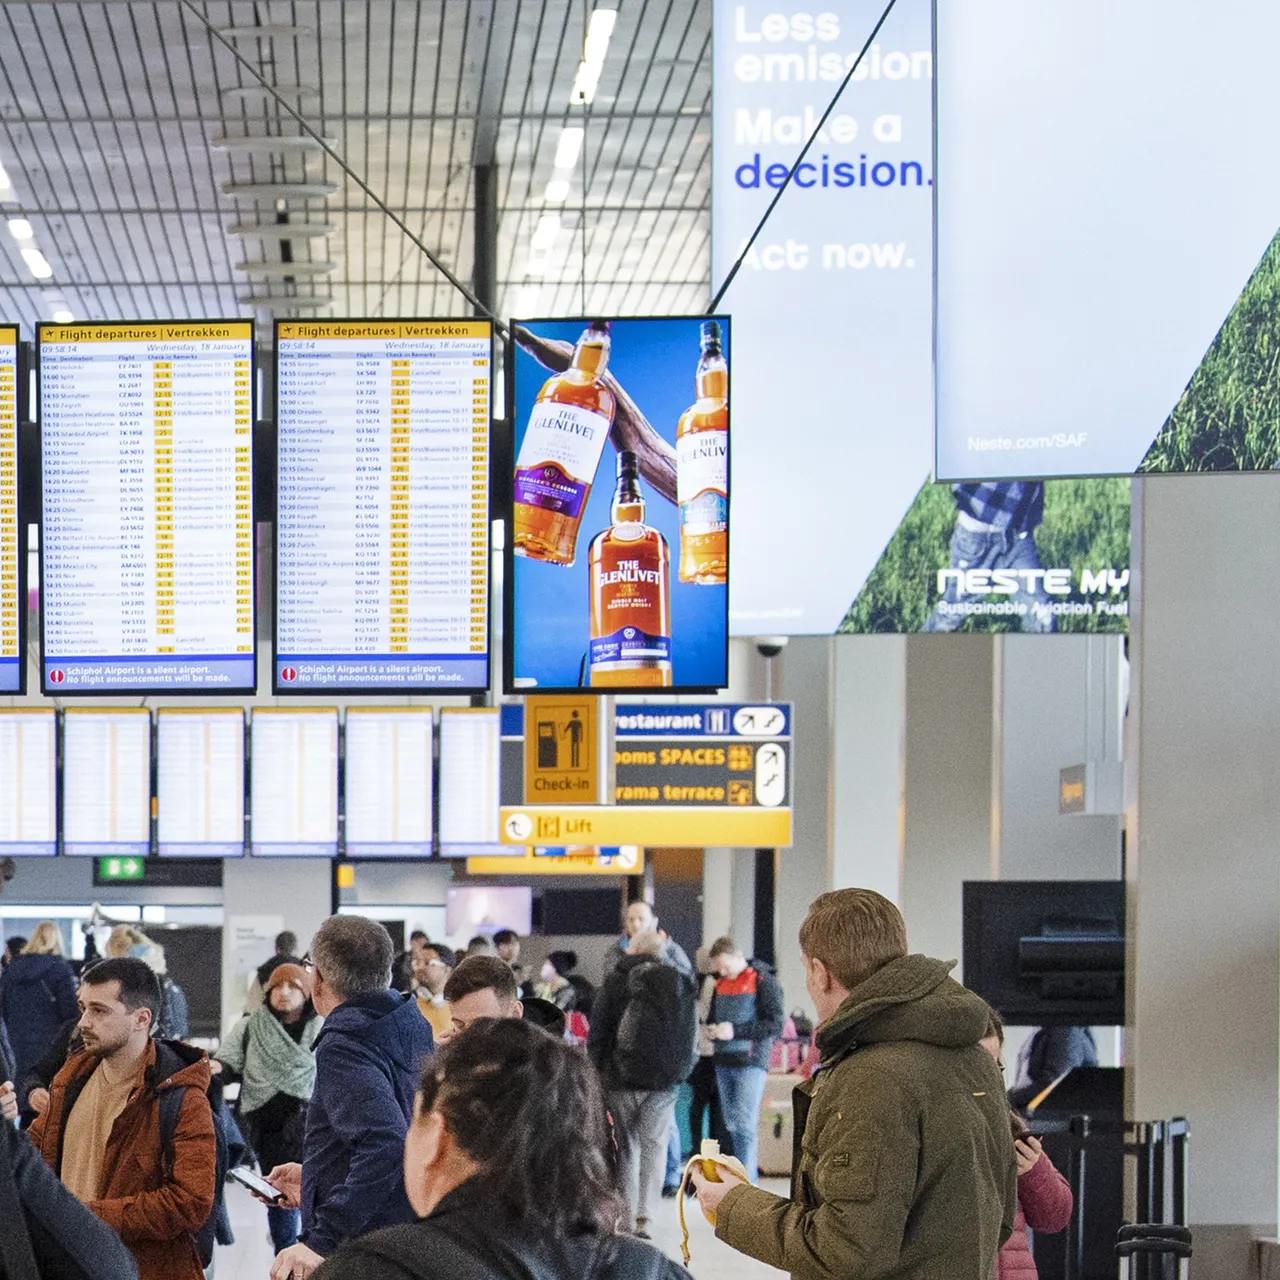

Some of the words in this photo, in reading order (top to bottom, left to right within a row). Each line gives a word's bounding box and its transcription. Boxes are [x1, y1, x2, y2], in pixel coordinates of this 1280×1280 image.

[736, 7, 840, 42] Less
[736, 105, 858, 145] Make
[874, 111, 901, 142] a
[735, 154, 933, 189] decision.
[736, 238, 810, 269] Act
[822, 241, 915, 269] now.
[60, 330, 92, 341] Flight
[96, 328, 157, 339] departures
[167, 328, 229, 338] Vertrekken
[298, 326, 331, 337] Flight
[334, 325, 395, 336] departures
[406, 325, 468, 336] Vertrekken
[385, 341, 436, 350] Wednesday,
[451, 341, 484, 349] January
[968, 432, 1087, 452] Neste.com/SAF
[617, 560, 640, 571] THE
[599, 570, 661, 587] GLENLIVET
[937, 569, 1071, 595] NESTE
[1080, 569, 1130, 593] MY
[939, 601, 1027, 616] Sustainable
[1031, 601, 1092, 616] Aviation
[1097, 600, 1128, 616] Fuel
[67, 667, 102, 676] Schiphol
[105, 667, 134, 676] Airport
[154, 666, 177, 674] silent
[179, 666, 210, 675] airport.
[82, 676, 104, 685] flight
[192, 674, 203, 682] be
[206, 674, 231, 682] made.
[660, 749, 725, 766] SPACES
[534, 777, 589, 791] Check-in
[663, 785, 724, 800] terrace
[566, 819, 592, 833] Lift
